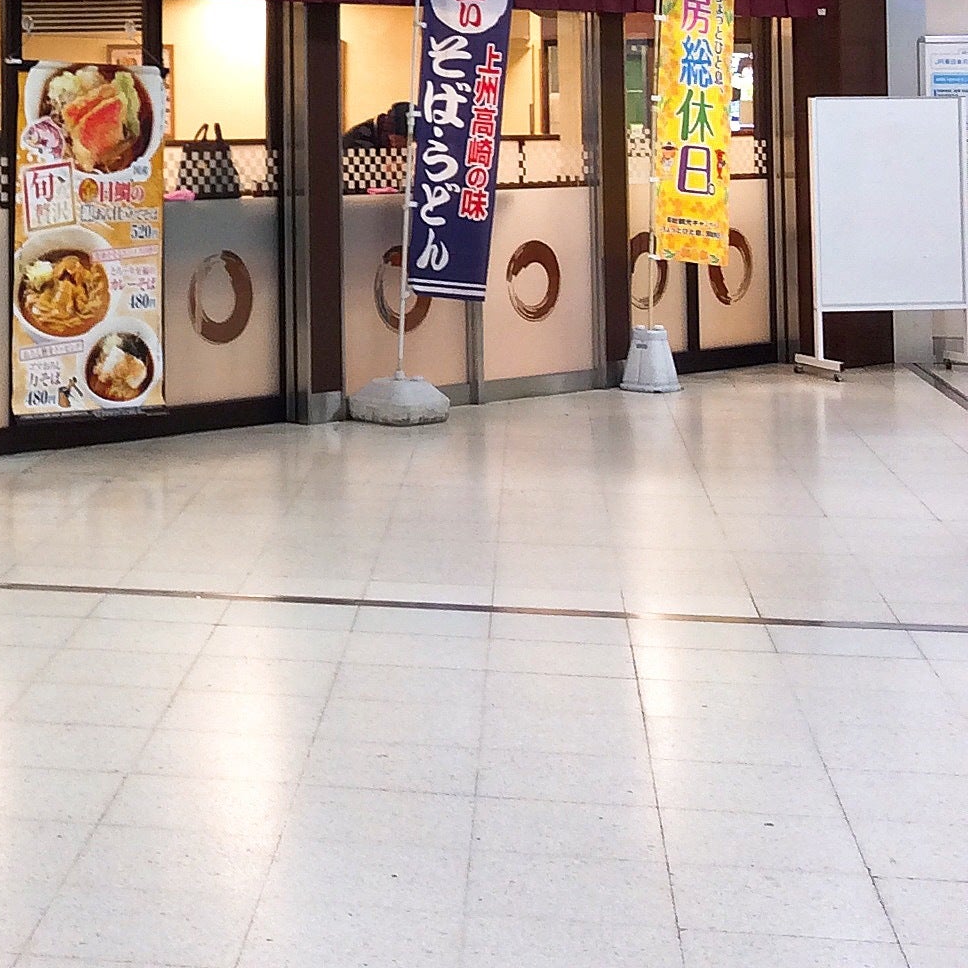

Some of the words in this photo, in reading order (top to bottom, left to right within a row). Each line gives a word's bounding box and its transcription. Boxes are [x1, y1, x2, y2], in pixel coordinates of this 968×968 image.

[415, 35, 473, 272] そば・うどん
[458, 43, 504, 222] 上州高崎の味
